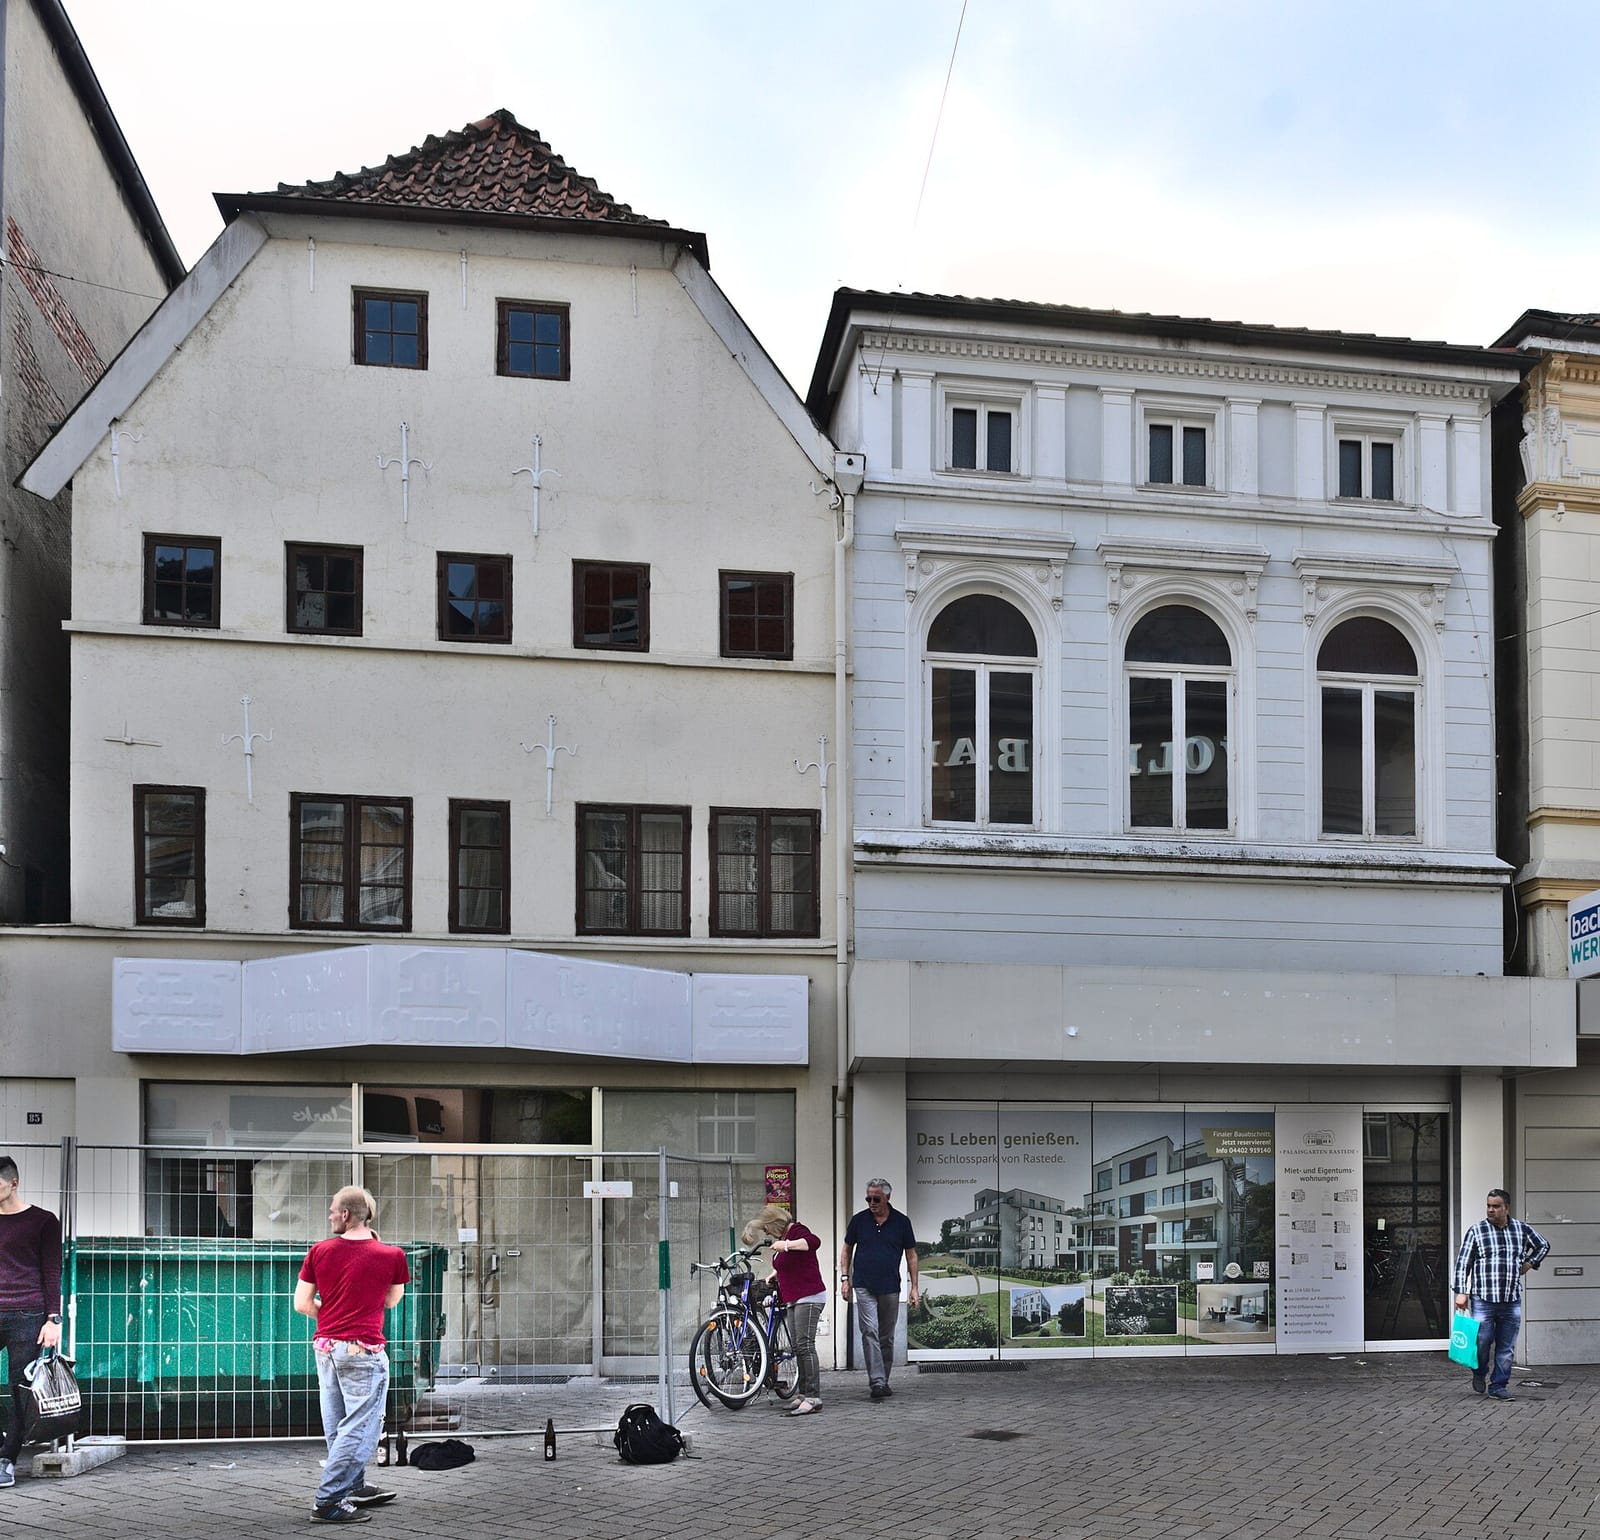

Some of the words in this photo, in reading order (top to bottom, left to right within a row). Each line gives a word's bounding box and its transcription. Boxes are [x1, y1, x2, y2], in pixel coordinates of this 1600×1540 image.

[1572, 906, 1600, 937] bac
[1571, 937, 1600, 965] WER
[916, 1132, 945, 1146] Das
[951, 1132, 997, 1146] Leben
[1003, 1132, 1080, 1149] genießen.
[917, 1154, 934, 1164] Am
[938, 1153, 998, 1166] Schlosspark
[1000, 1155, 1020, 1164] von
[1023, 1153, 1067, 1164] Rastede.
[1300, 1175, 1339, 1183] wohnungen
[1317, 1167, 1355, 1176] Eigentums-
